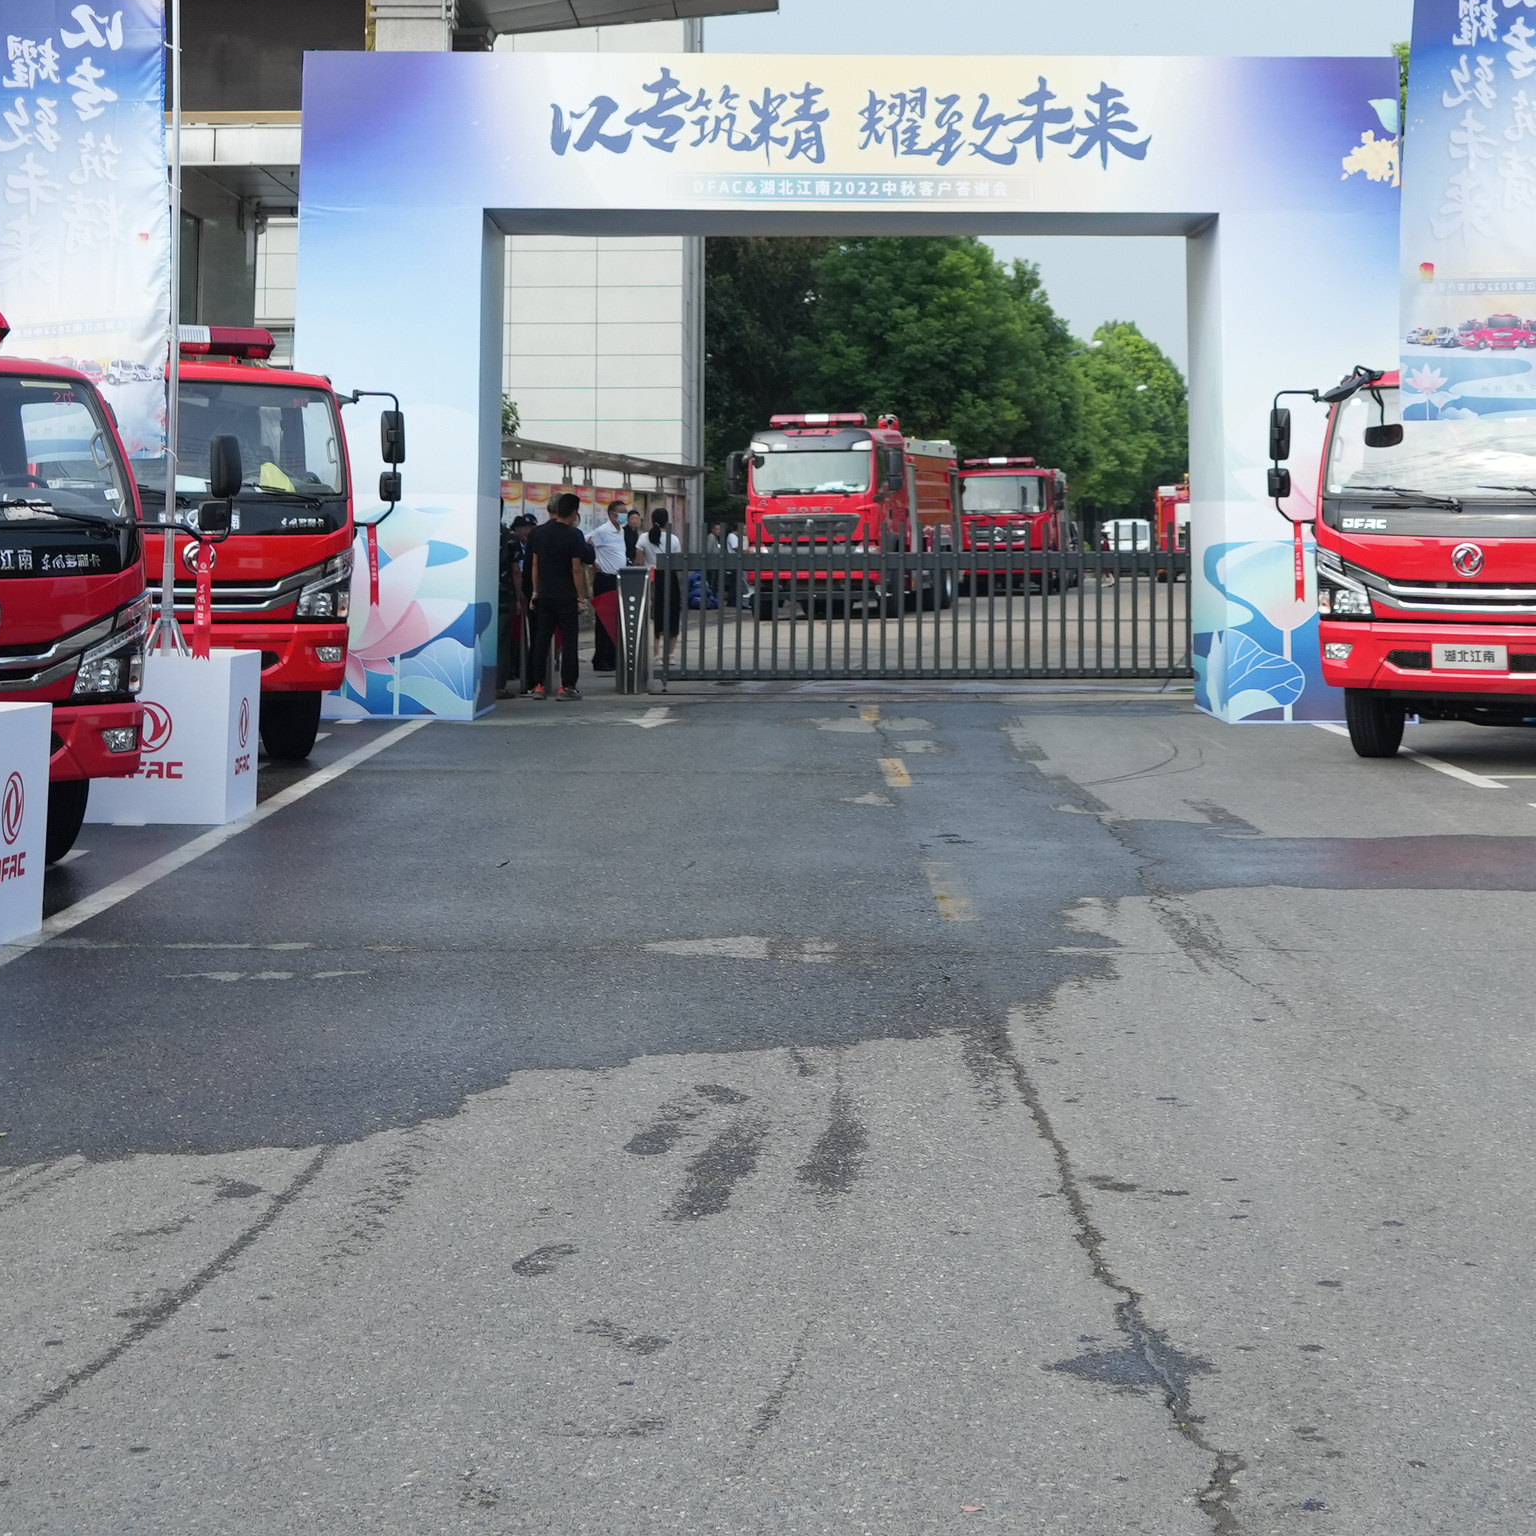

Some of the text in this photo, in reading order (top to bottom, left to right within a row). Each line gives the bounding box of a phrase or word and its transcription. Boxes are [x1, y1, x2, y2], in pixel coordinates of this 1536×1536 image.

[549, 66, 1153, 171] 以专筑精 耀致未来
[1342, 518, 1387, 530] DFAC
[0, 548, 33, 571] 江南
[1444, 649, 1496, 665] 湖北江南
[107, 760, 184, 779] FAC
[234, 755, 251, 776] DFAC
